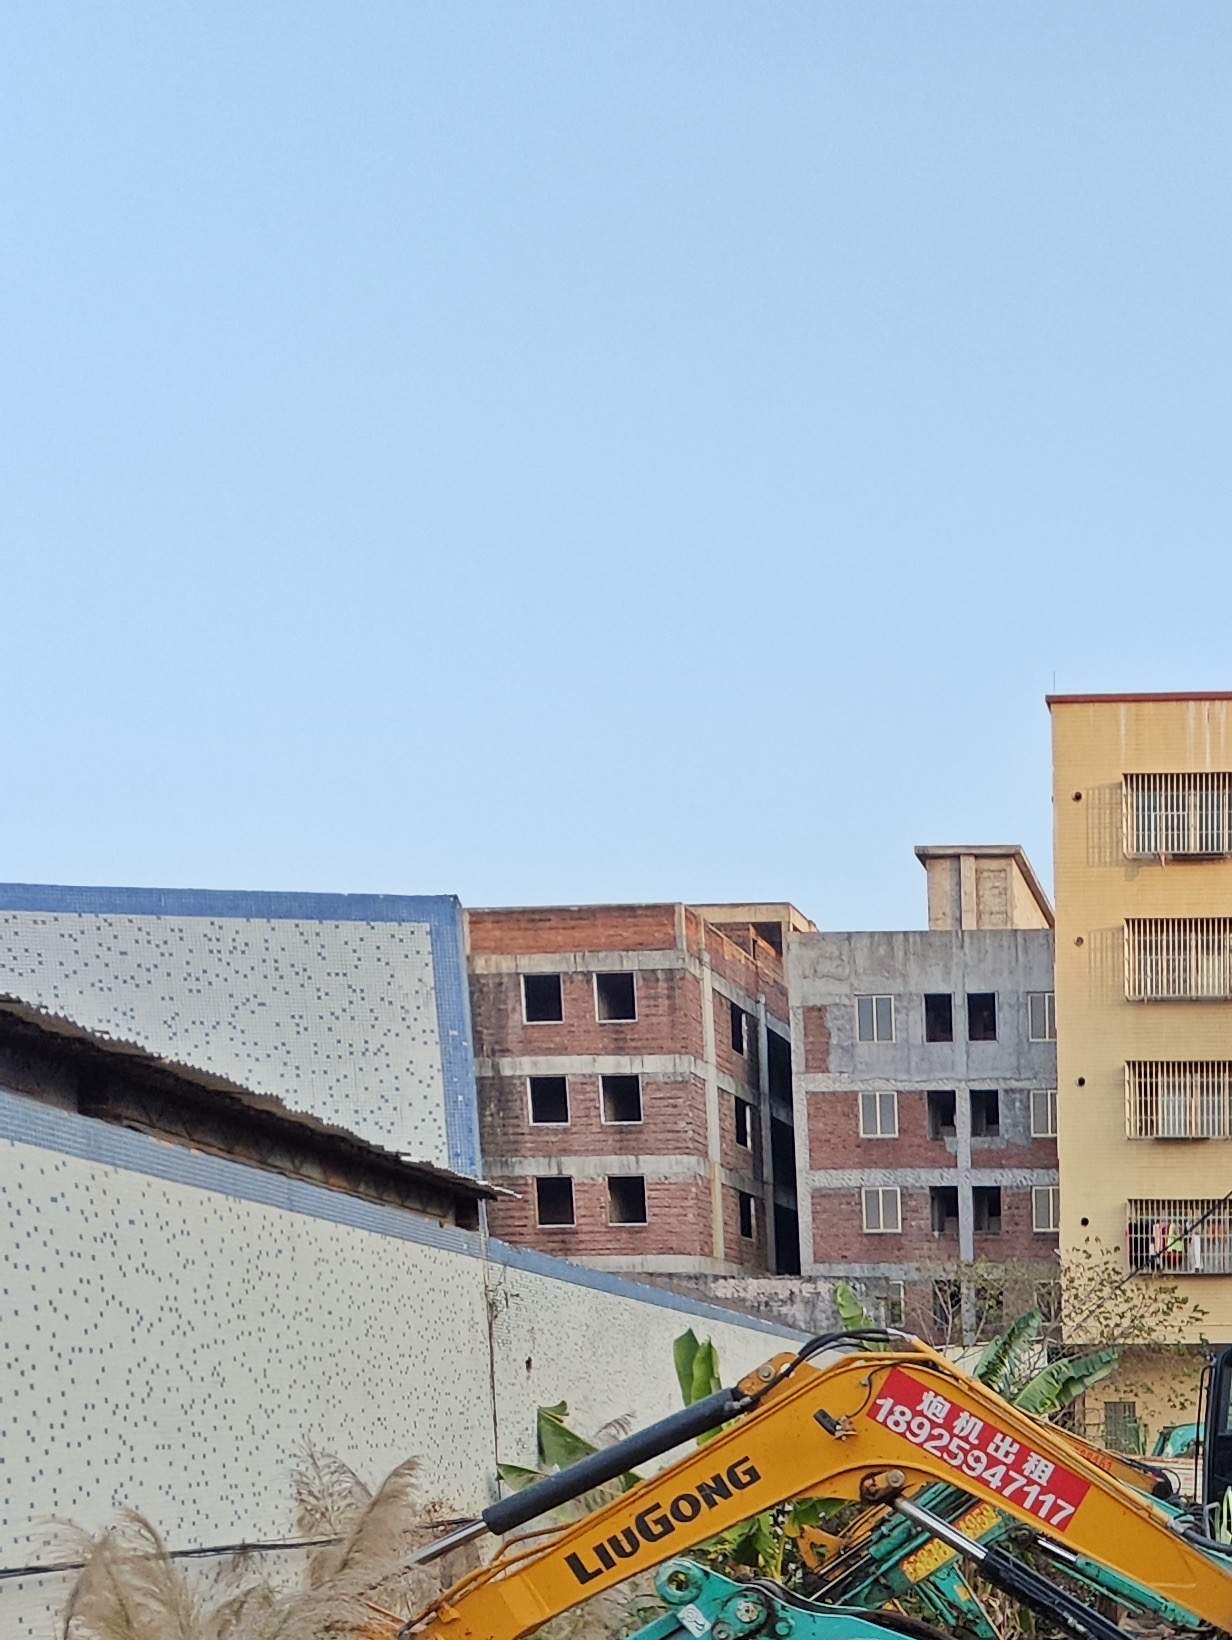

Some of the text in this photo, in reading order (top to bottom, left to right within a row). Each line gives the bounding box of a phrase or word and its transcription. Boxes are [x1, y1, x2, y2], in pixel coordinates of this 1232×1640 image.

[876, 1397, 1075, 1526] 18925947117
[916, 1391, 1055, 1487] 炮机出租
[564, 1455, 762, 1585] LIUGONG
